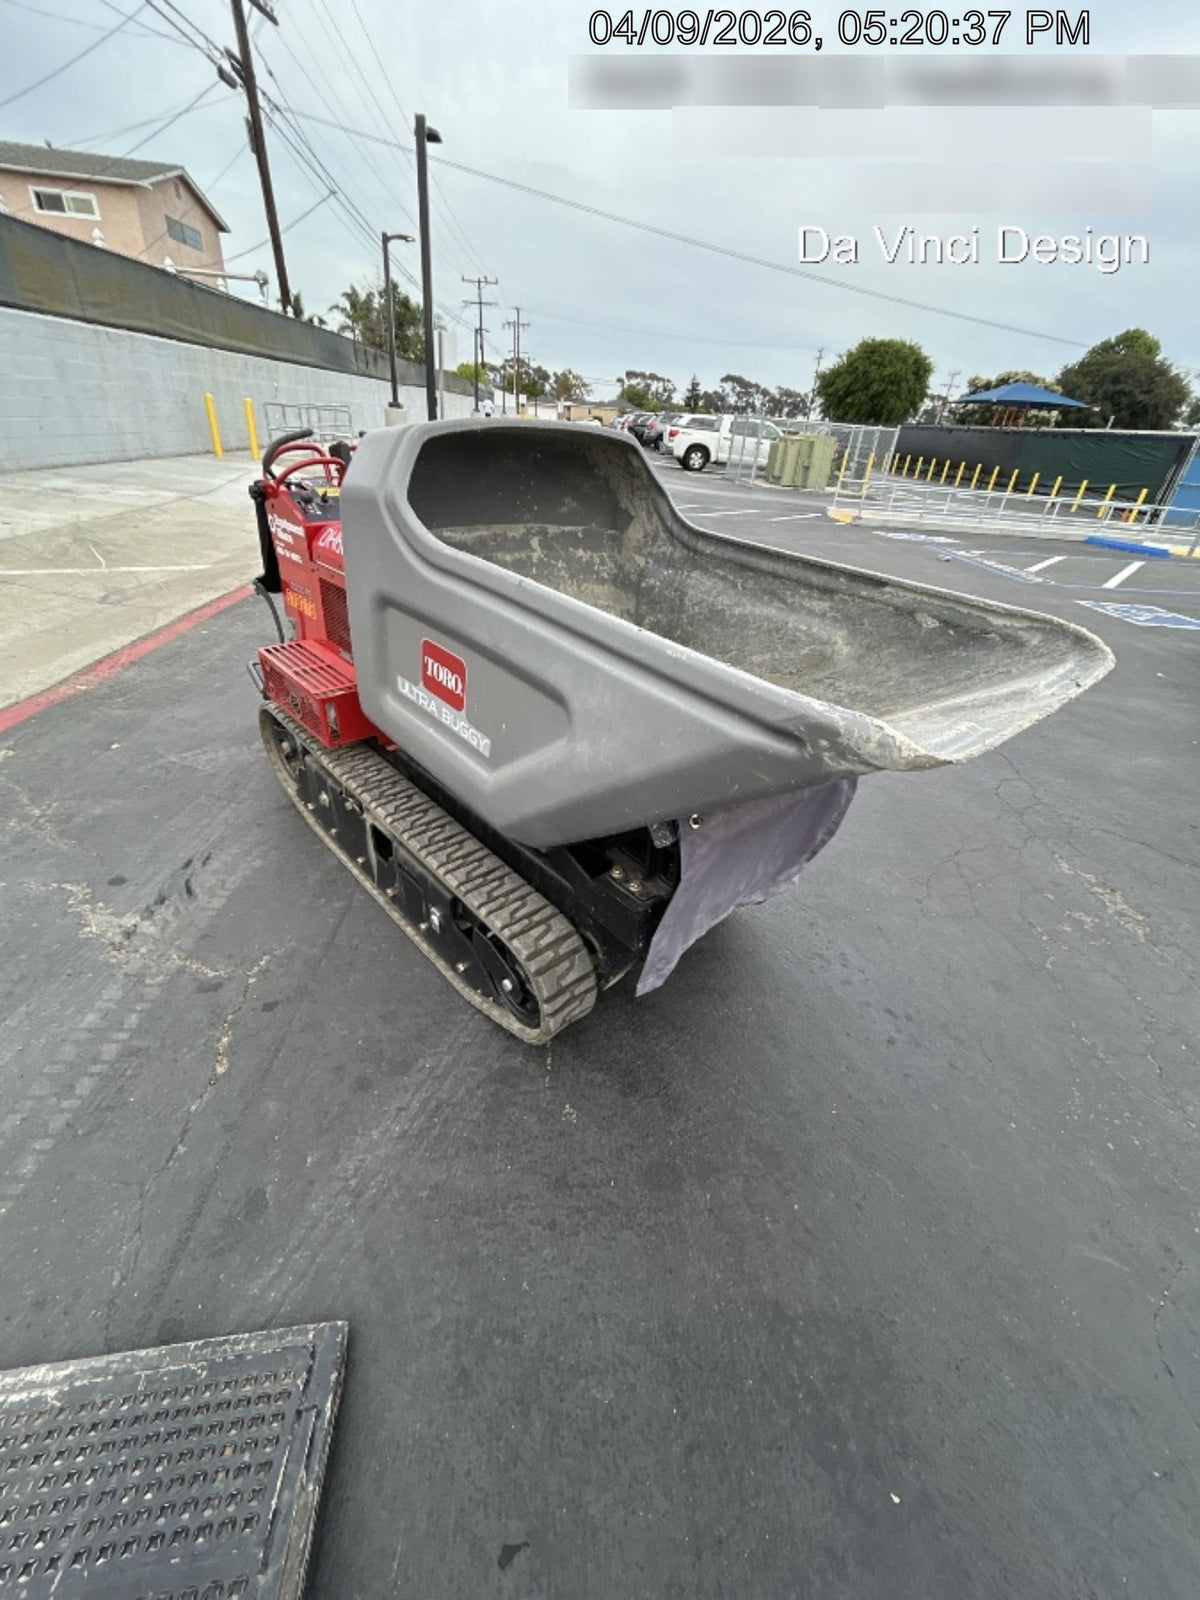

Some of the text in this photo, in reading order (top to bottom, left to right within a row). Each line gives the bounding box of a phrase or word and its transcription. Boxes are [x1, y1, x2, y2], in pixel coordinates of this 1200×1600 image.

[424, 655, 463, 697] TORO
[397, 675, 489, 755] ULTRA BUGGY
